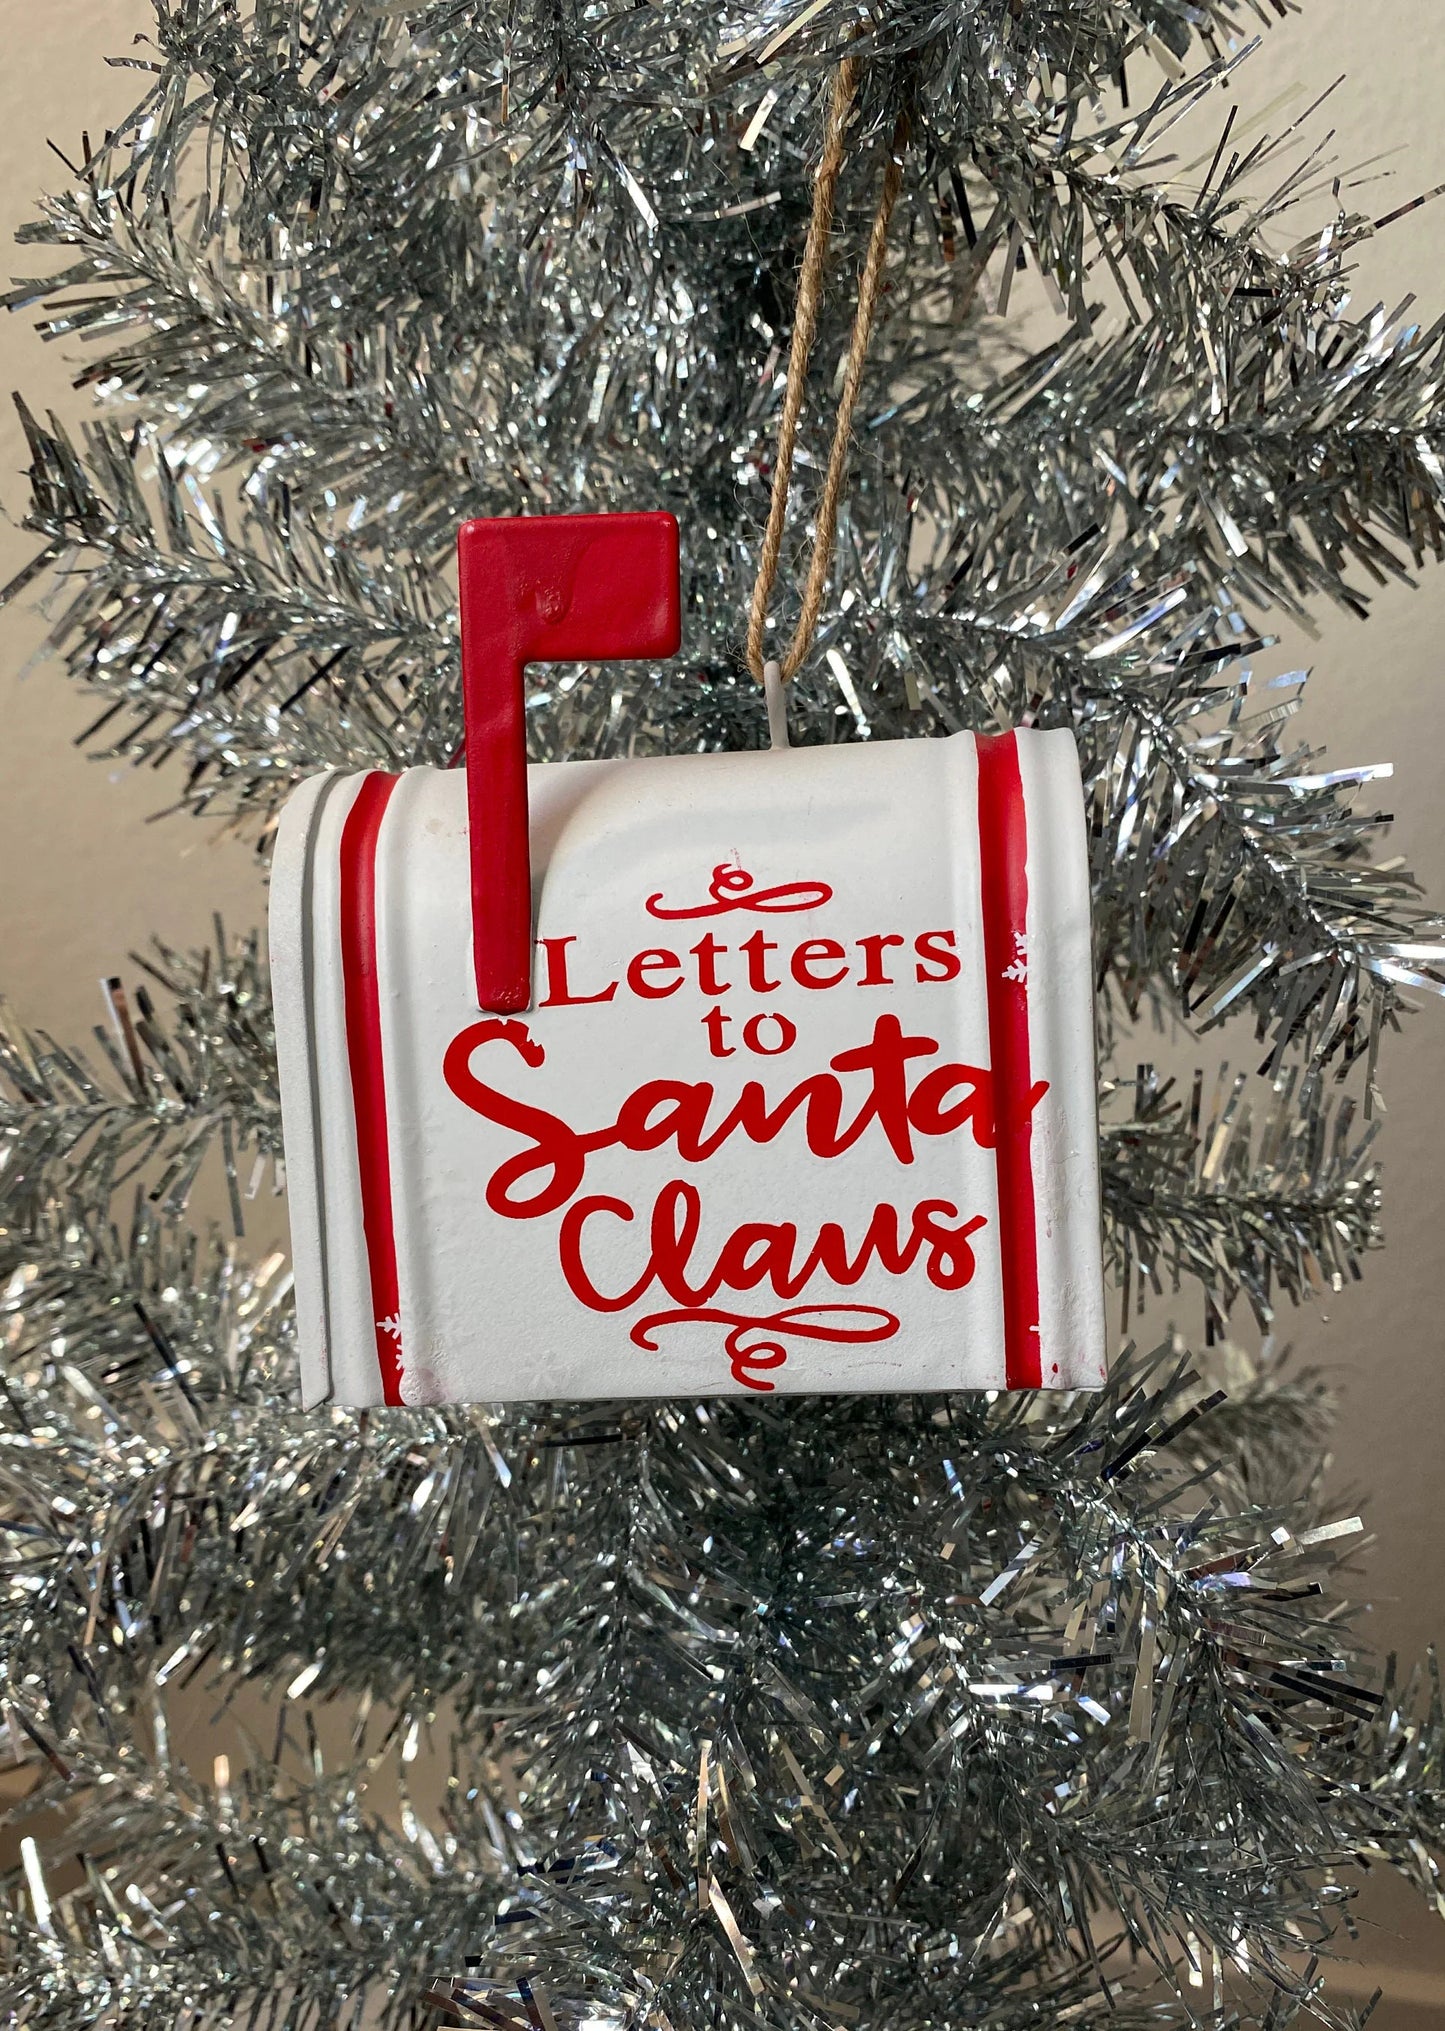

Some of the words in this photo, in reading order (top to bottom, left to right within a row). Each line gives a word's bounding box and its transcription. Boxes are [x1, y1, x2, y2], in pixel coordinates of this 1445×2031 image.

[538, 929, 962, 1008] Letters
[700, 1005, 798, 1058] to
[442, 1014, 1050, 1219] Santa
[558, 1179, 988, 1313] Claus
